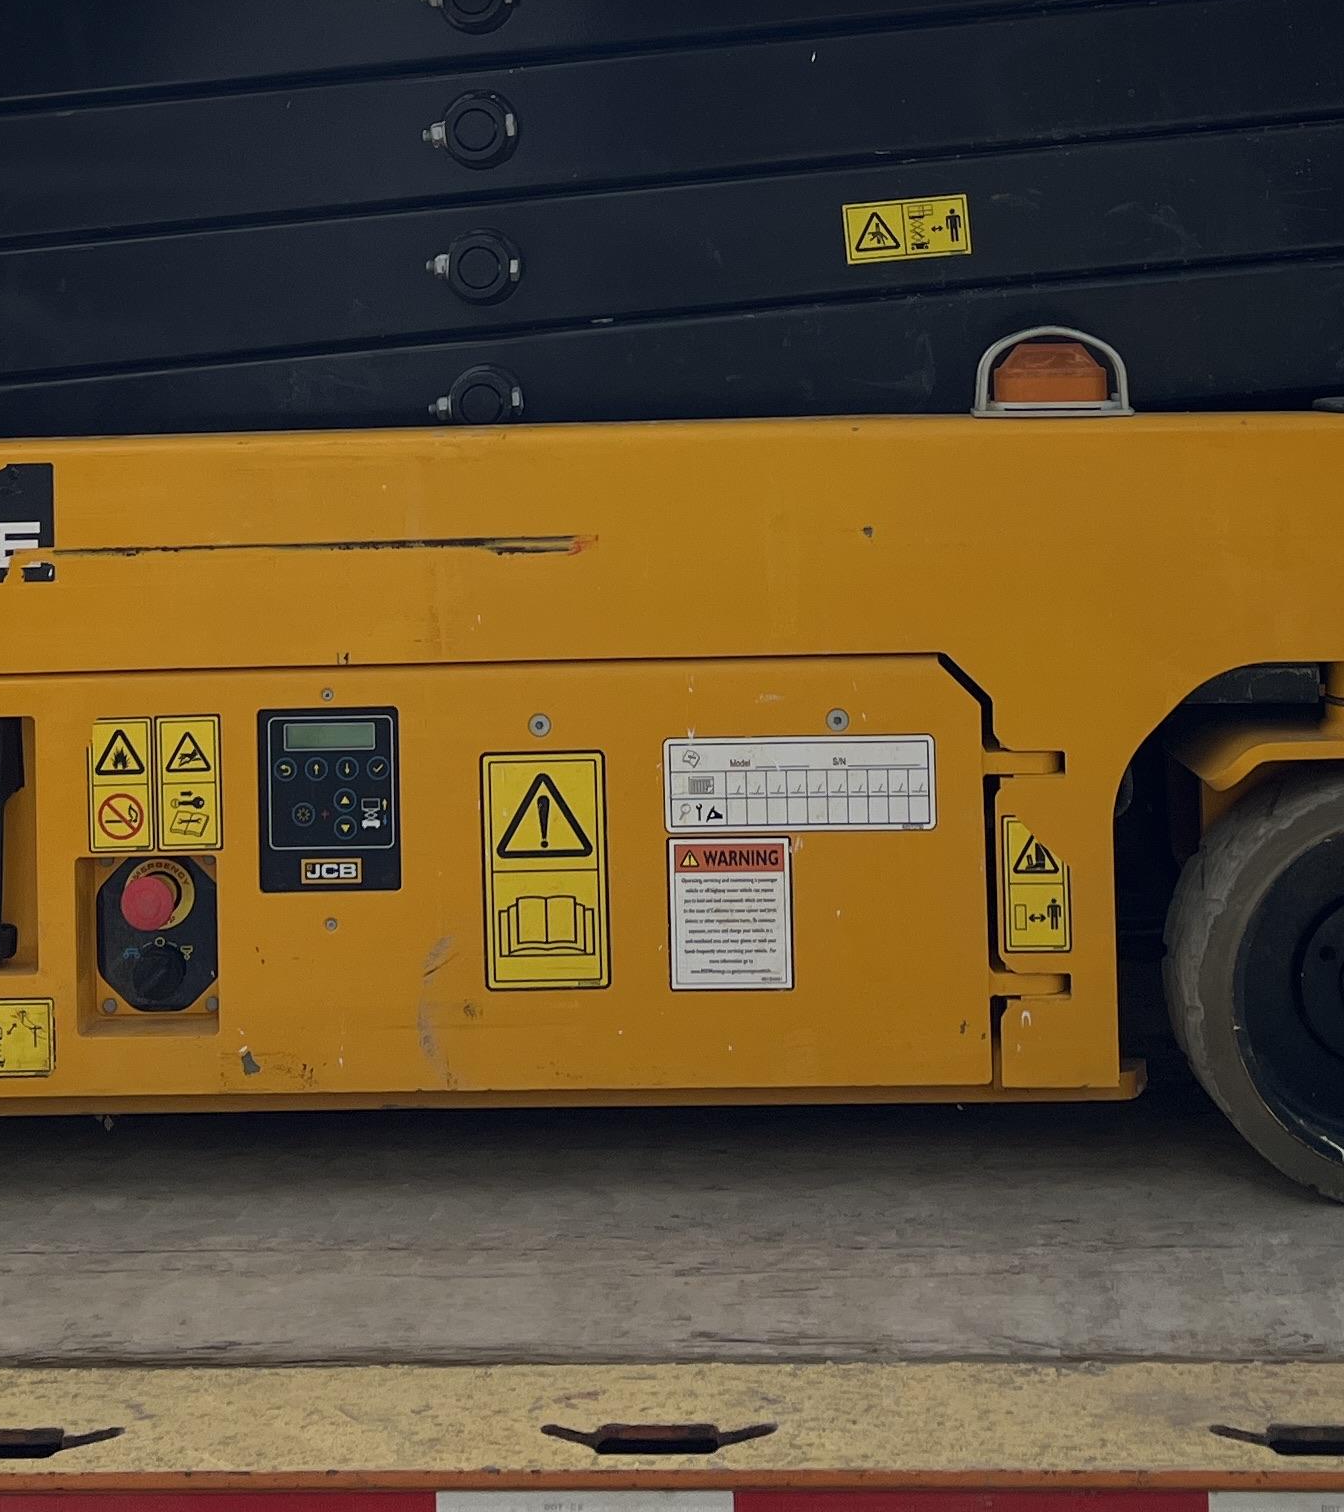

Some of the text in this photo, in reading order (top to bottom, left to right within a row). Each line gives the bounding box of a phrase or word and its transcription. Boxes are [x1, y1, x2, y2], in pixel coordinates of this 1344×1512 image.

[730, 757, 847, 768] Model S/N
[703, 849, 779, 867] WARNING
[306, 863, 357, 879] JCB
